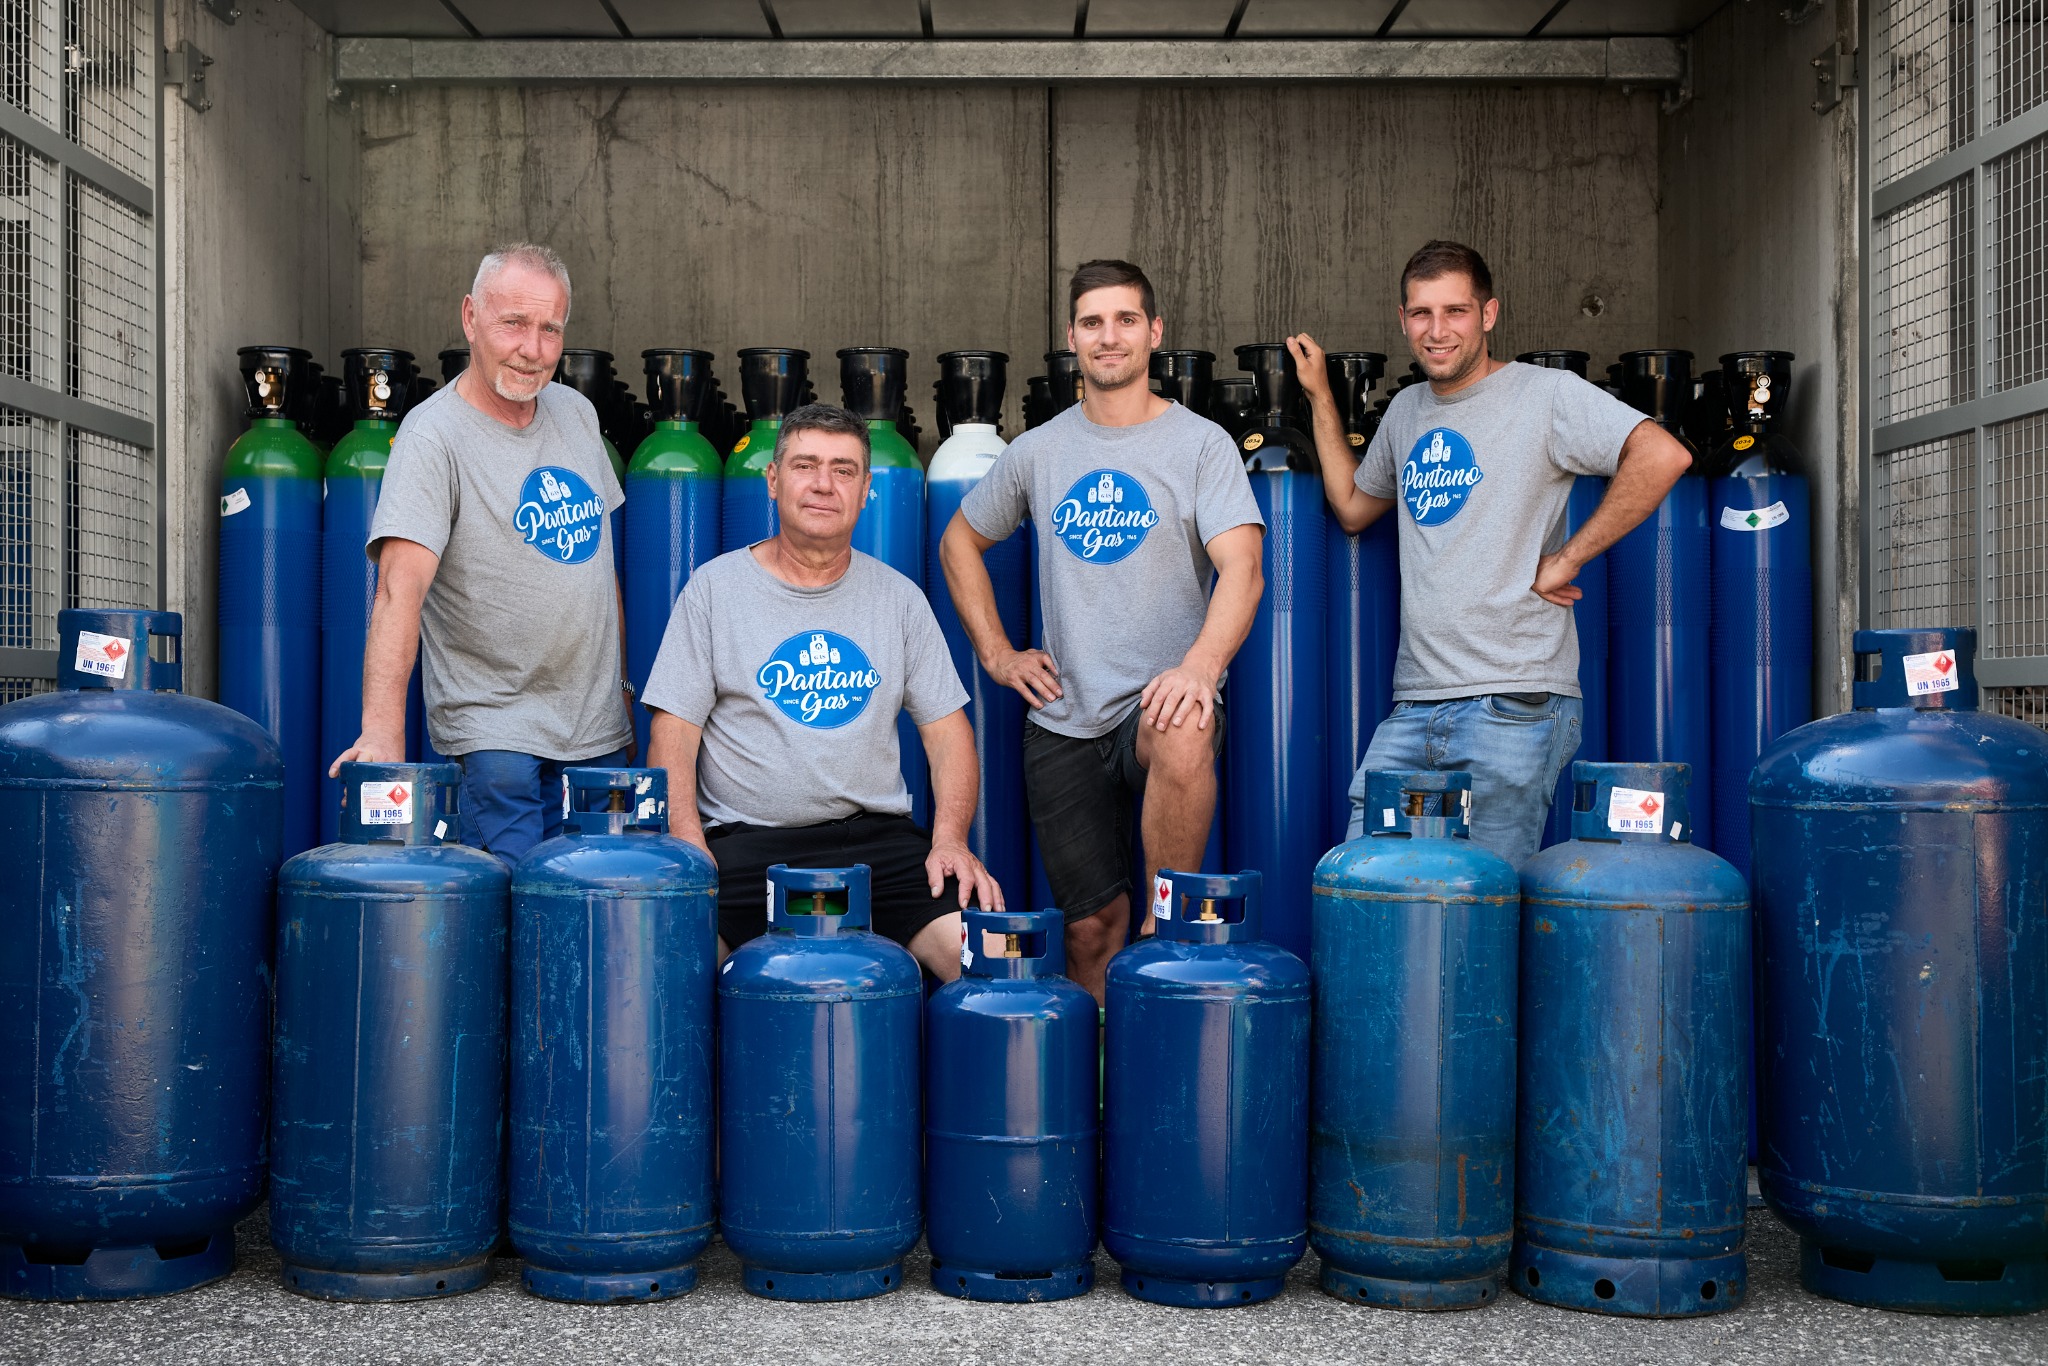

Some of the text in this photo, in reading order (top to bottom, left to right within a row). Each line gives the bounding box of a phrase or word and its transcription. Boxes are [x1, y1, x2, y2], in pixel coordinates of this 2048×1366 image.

[1401, 460, 1482, 497] Pantano
[515, 495, 604, 542] Pantano
[1053, 498, 1159, 535] Pantano
[1416, 489, 1451, 521] Gas
[556, 525, 592, 561] Gas
[1082, 527, 1125, 559] Gas
[83, 659, 93, 669] UN
[97, 662, 115, 673] 1965
[759, 659, 881, 698] Pantano
[1917, 681, 1929, 690] UN
[1932, 678, 1950, 688] 1965
[800, 690, 850, 723] Gas
[370, 809, 380, 818] UN
[383, 809, 403, 818] 1965
[1620, 819, 1631, 828] UN
[1635, 820, 1654, 829] 1965
